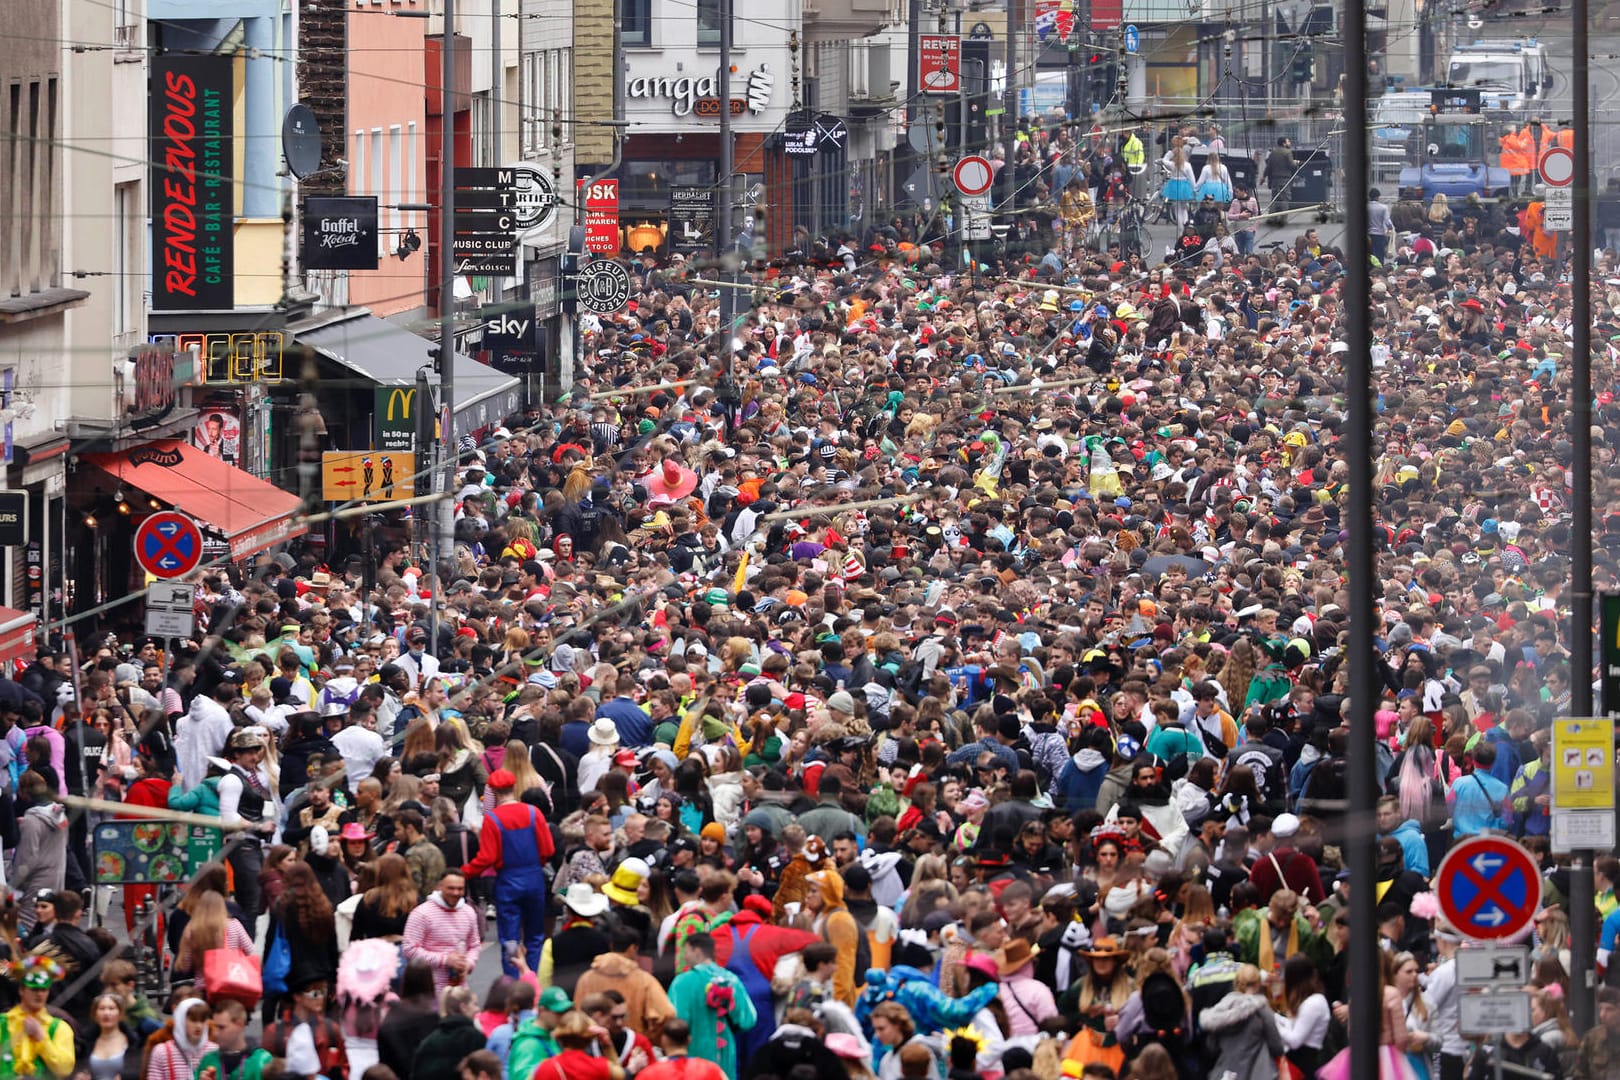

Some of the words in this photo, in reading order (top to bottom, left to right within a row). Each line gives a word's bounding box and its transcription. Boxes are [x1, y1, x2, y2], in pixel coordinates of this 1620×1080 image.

[625, 66, 721, 117] anga
[701, 100, 741, 113] DÖER
[204, 89, 221, 188] RESTAURANT
[164, 71, 197, 296] RENDEZVOUS
[498, 171, 512, 184] M
[499, 193, 510, 206] T
[205, 202, 221, 231] BAR
[498, 216, 511, 230] C
[320, 217, 360, 234] Gaffel
[319, 233, 360, 249] Kölsch
[453, 240, 482, 249] MUSIC
[484, 240, 512, 249] CLUB
[203, 245, 221, 285] CAFÉ
[480, 262, 511, 271] KÖLSCH
[593, 277, 613, 297] K&B
[579, 291, 627, 312] 9383320
[488, 313, 529, 340] sky
[382, 430, 391, 438] in
[391, 430, 401, 438] 50
